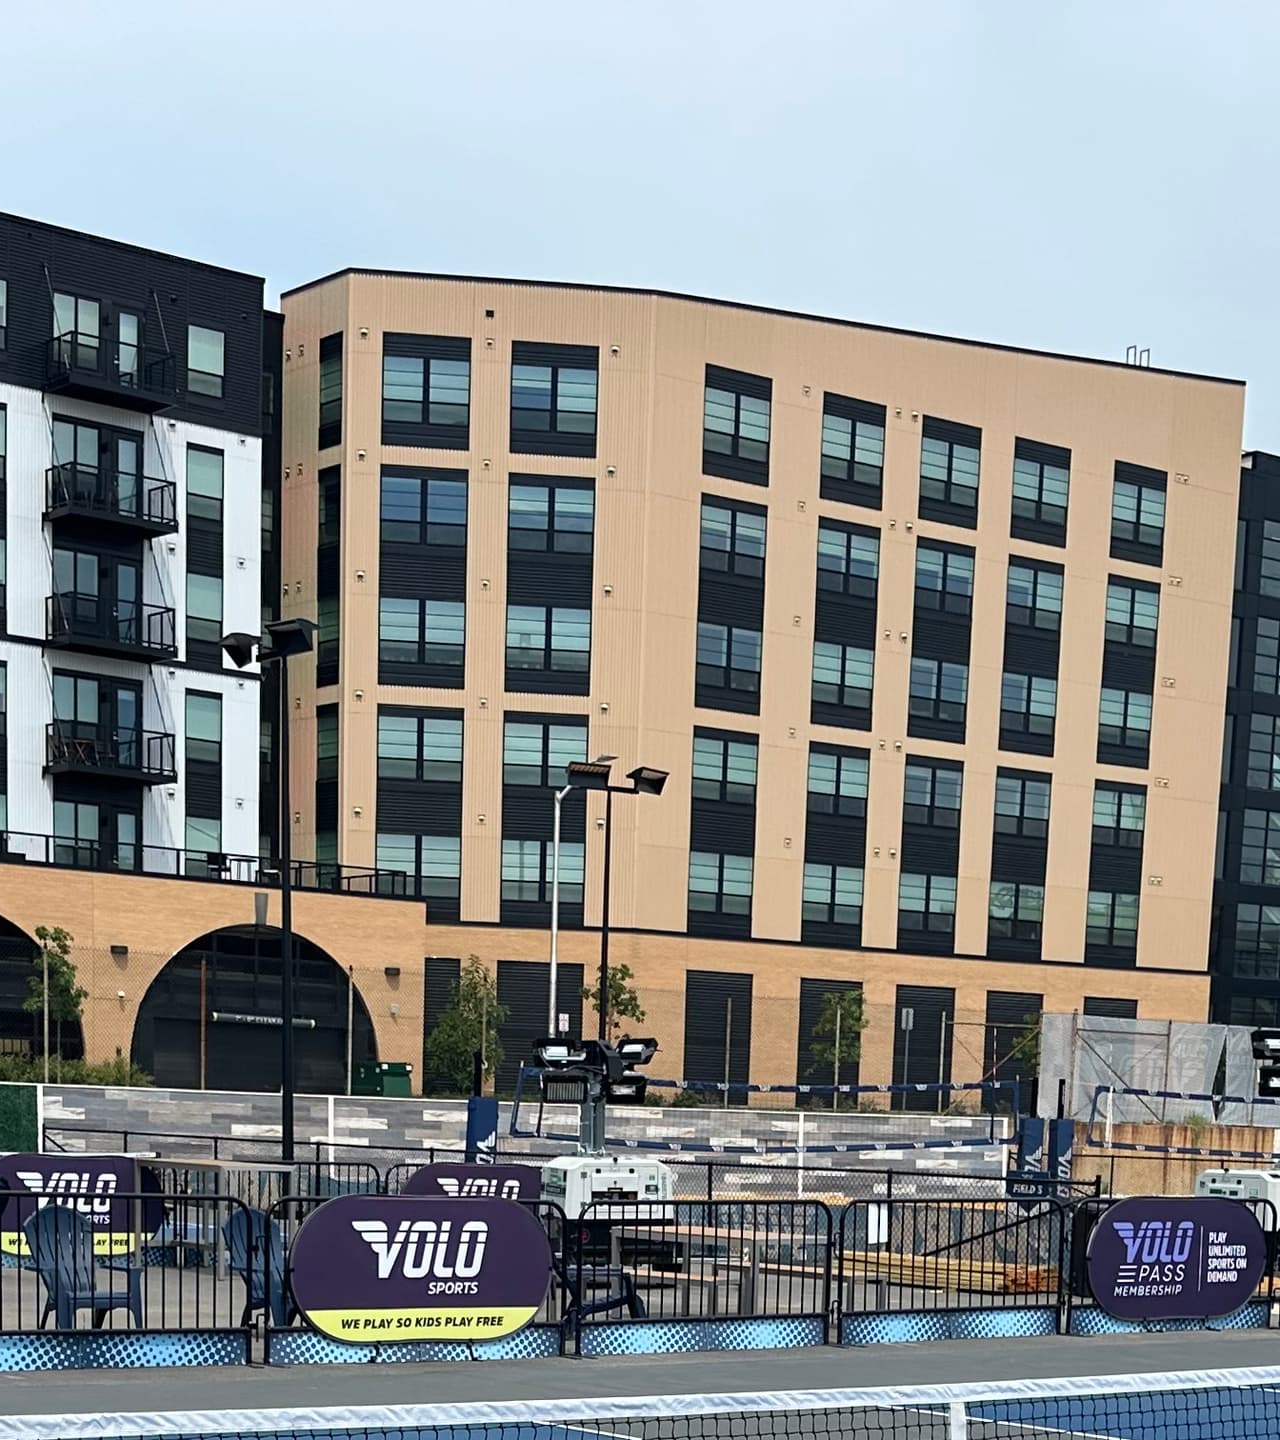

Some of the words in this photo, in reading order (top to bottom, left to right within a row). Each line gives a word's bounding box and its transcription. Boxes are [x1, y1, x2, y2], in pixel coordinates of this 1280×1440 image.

[16, 1172, 117, 1212] VOLO
[1013, 1184, 1036, 1194] FIELD
[1112, 1221, 1194, 1263] VOLO
[1208, 1232, 1227, 1244] PLAY
[352, 1220, 488, 1279] VOLO
[1208, 1245, 1246, 1257] UNLIMITED
[1207, 1258, 1234, 1270] SPORTS
[1236, 1258, 1247, 1269] ON
[1139, 1264, 1185, 1282] PASS
[1207, 1271, 1237, 1283] DEMAND
[428, 1281, 478, 1295] SPORTS
[1113, 1284, 1182, 1297] MEMBERSHIP
[341, 1319, 361, 1329] WE
[364, 1318, 393, 1329] PLAY
[396, 1318, 412, 1328] SO
[415, 1317, 442, 1328] KIDS
[445, 1317, 474, 1327] PLAY
[476, 1316, 504, 1327] FREE
